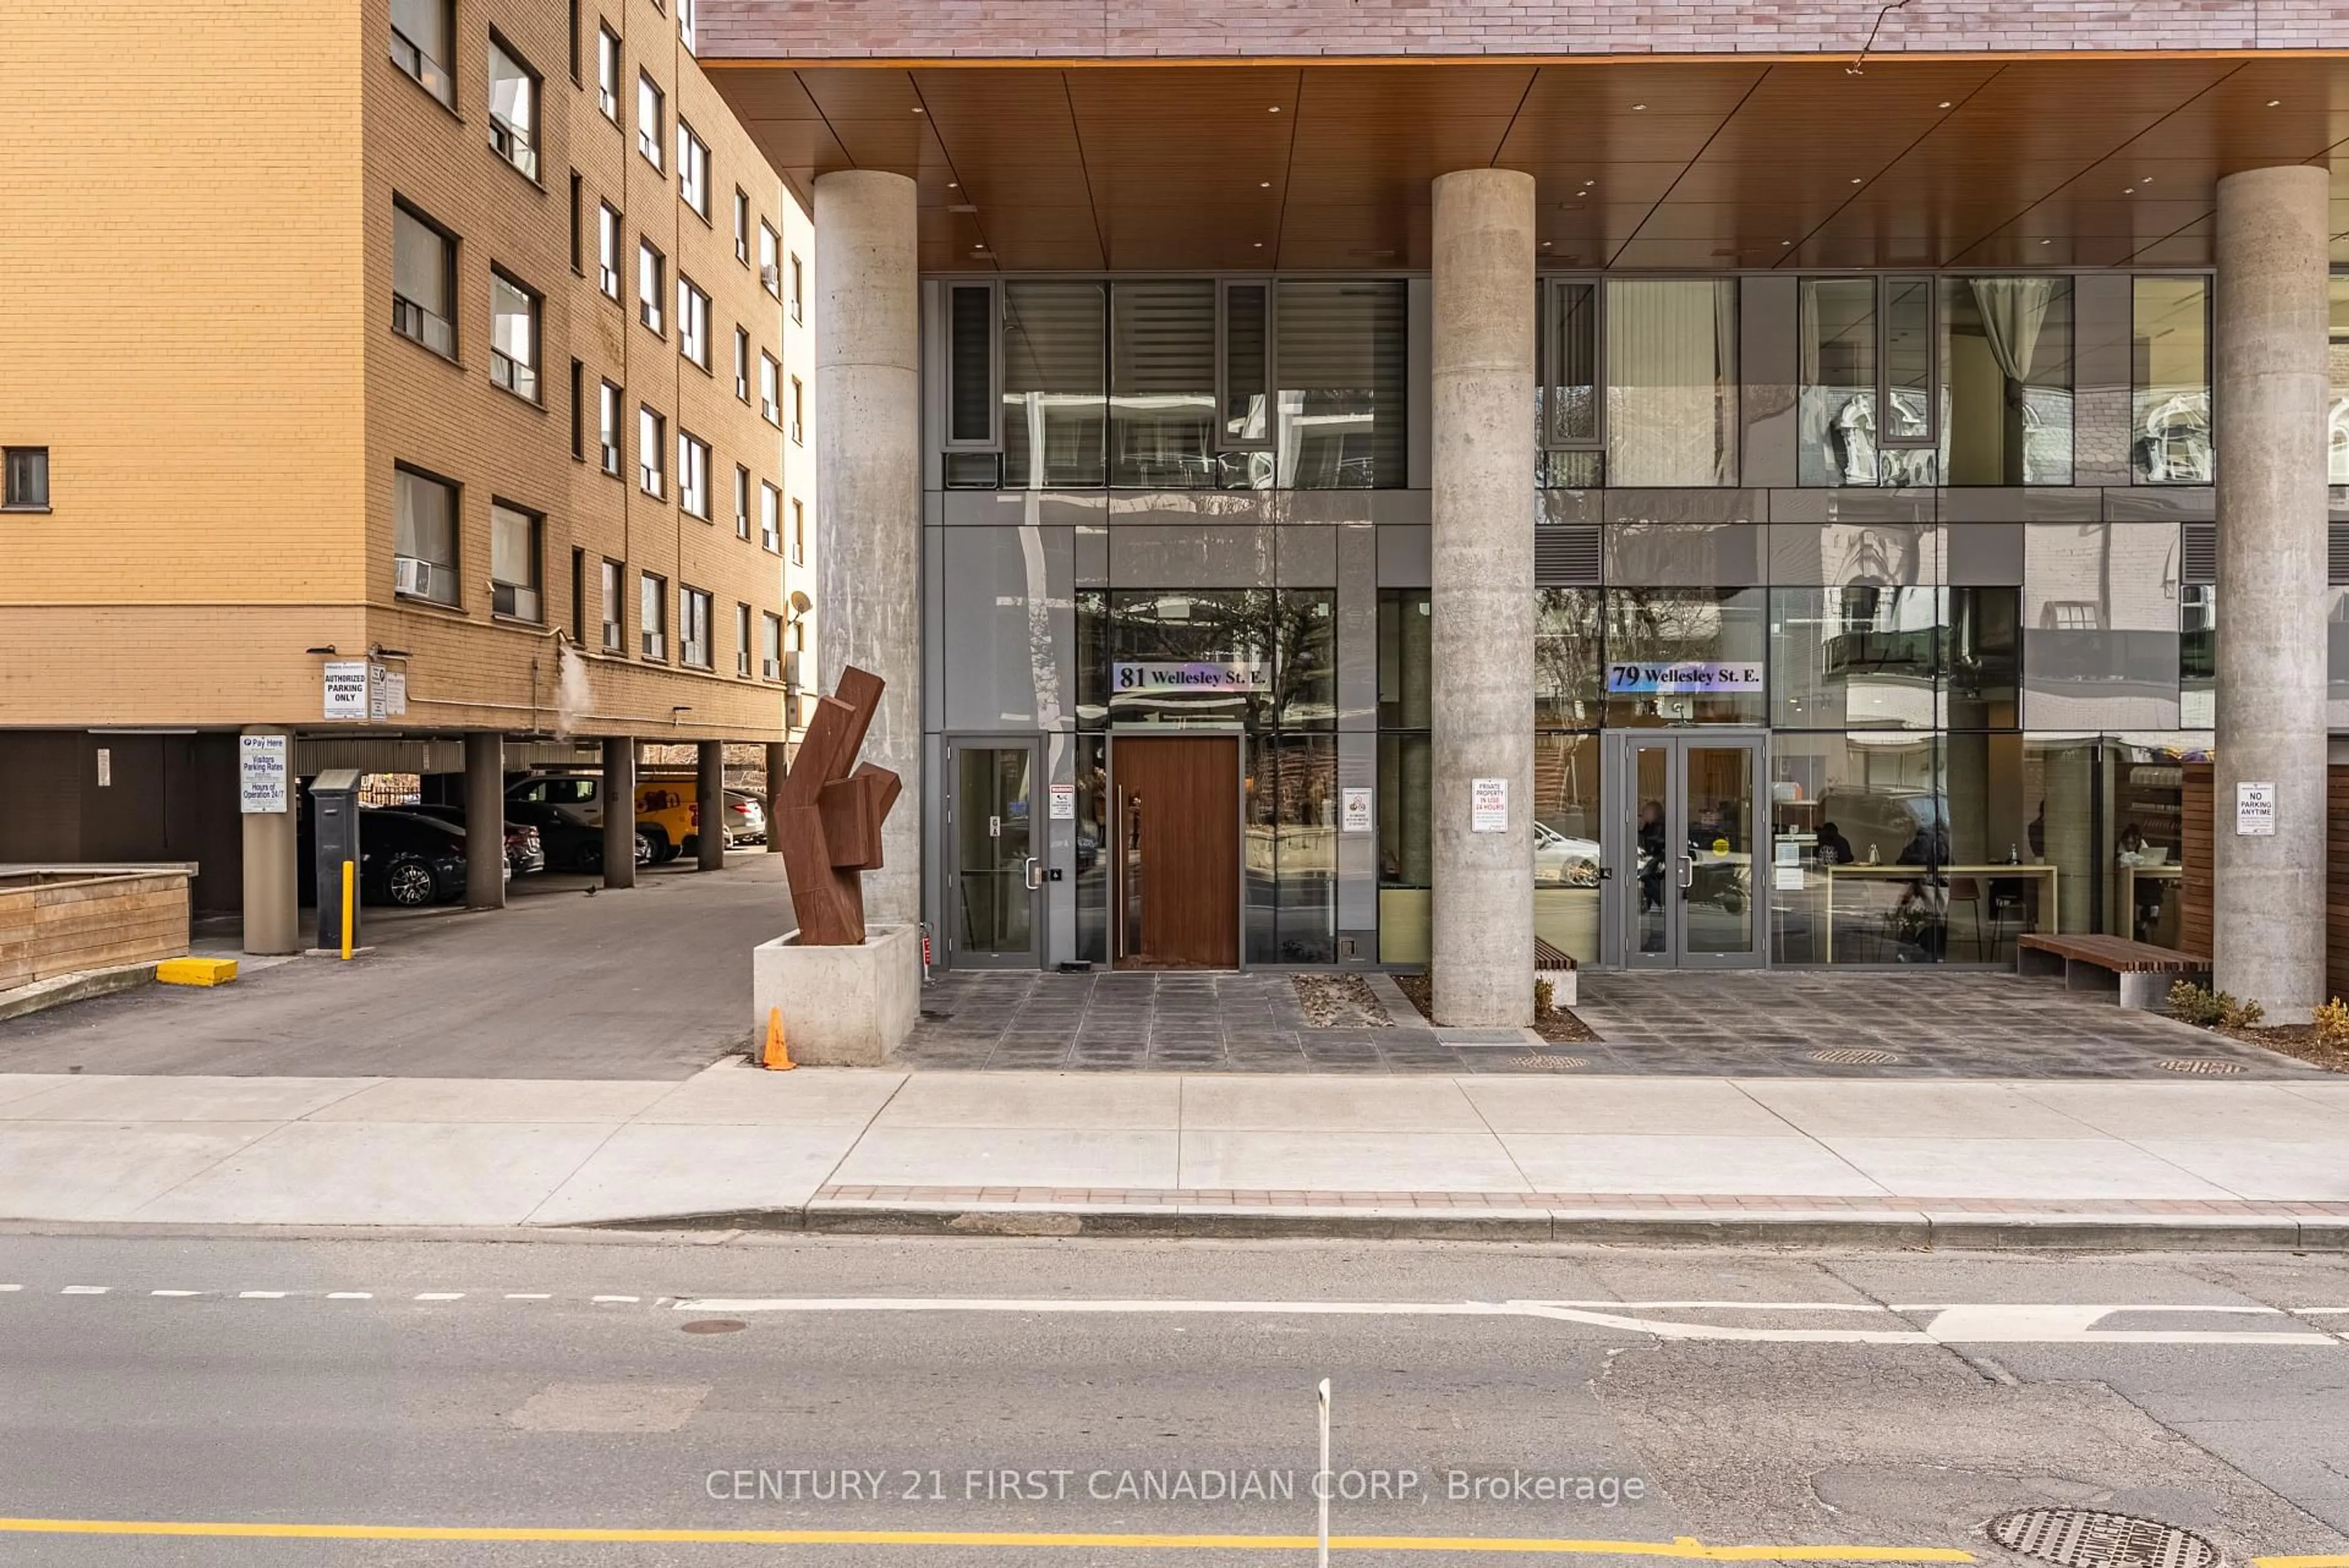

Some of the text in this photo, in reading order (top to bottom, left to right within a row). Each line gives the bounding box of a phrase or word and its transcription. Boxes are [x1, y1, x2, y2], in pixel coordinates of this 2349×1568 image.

[1120, 667, 1266, 688] 81 Wellesley St. E.
[1613, 666, 1759, 686] 79 Wellesley St. E.
[253, 739, 265, 749] Pay
[243, 763, 265, 772] Parking
[243, 790, 270, 799] Operation
[2249, 792, 2263, 801] NO
